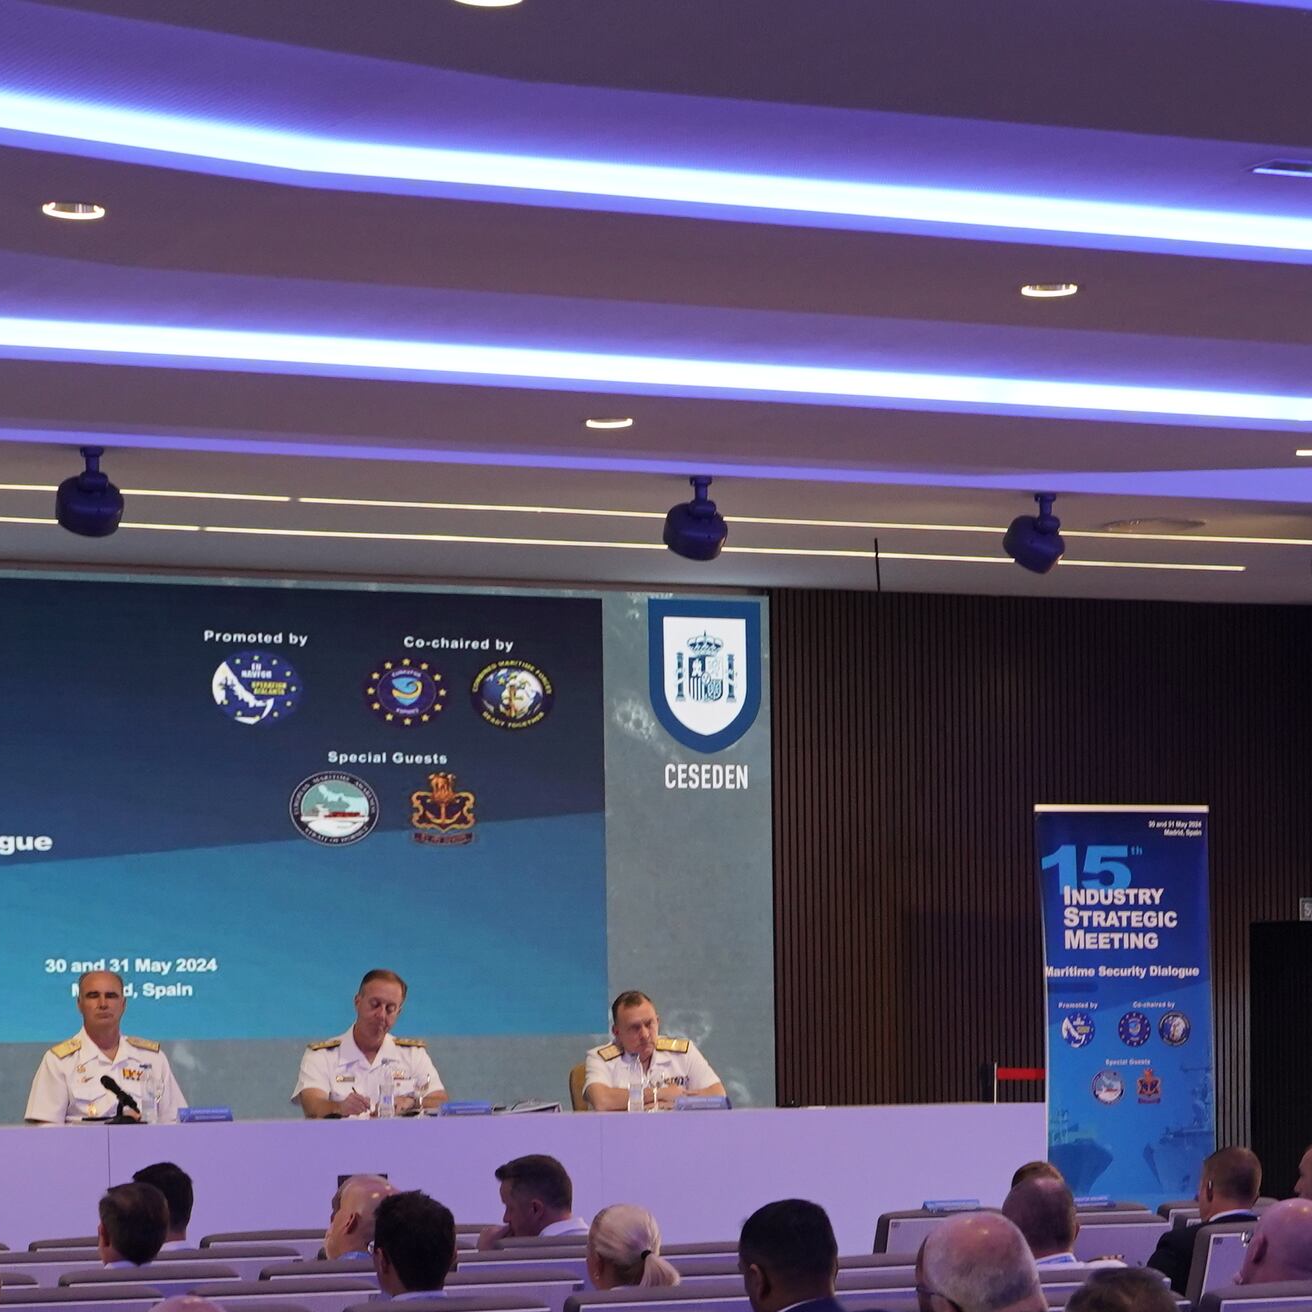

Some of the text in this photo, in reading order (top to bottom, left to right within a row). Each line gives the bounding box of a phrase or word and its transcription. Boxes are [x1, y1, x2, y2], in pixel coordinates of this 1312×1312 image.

[204, 630, 308, 647] Promoted by
[403, 636, 514, 652] Co-chaired by
[327, 750, 448, 765] Special Guests
[665, 763, 749, 790] CESEDEN
[1063, 885, 1164, 905] INDUSTRY
[1063, 907, 1178, 928] STRATEGIC
[1064, 929, 1159, 950] MEETING
[45, 958, 218, 975] 30 and 31 May 2024
[1045, 965, 1200, 979] Maritime Security Dialogue
[142, 983, 193, 1000] Spain
